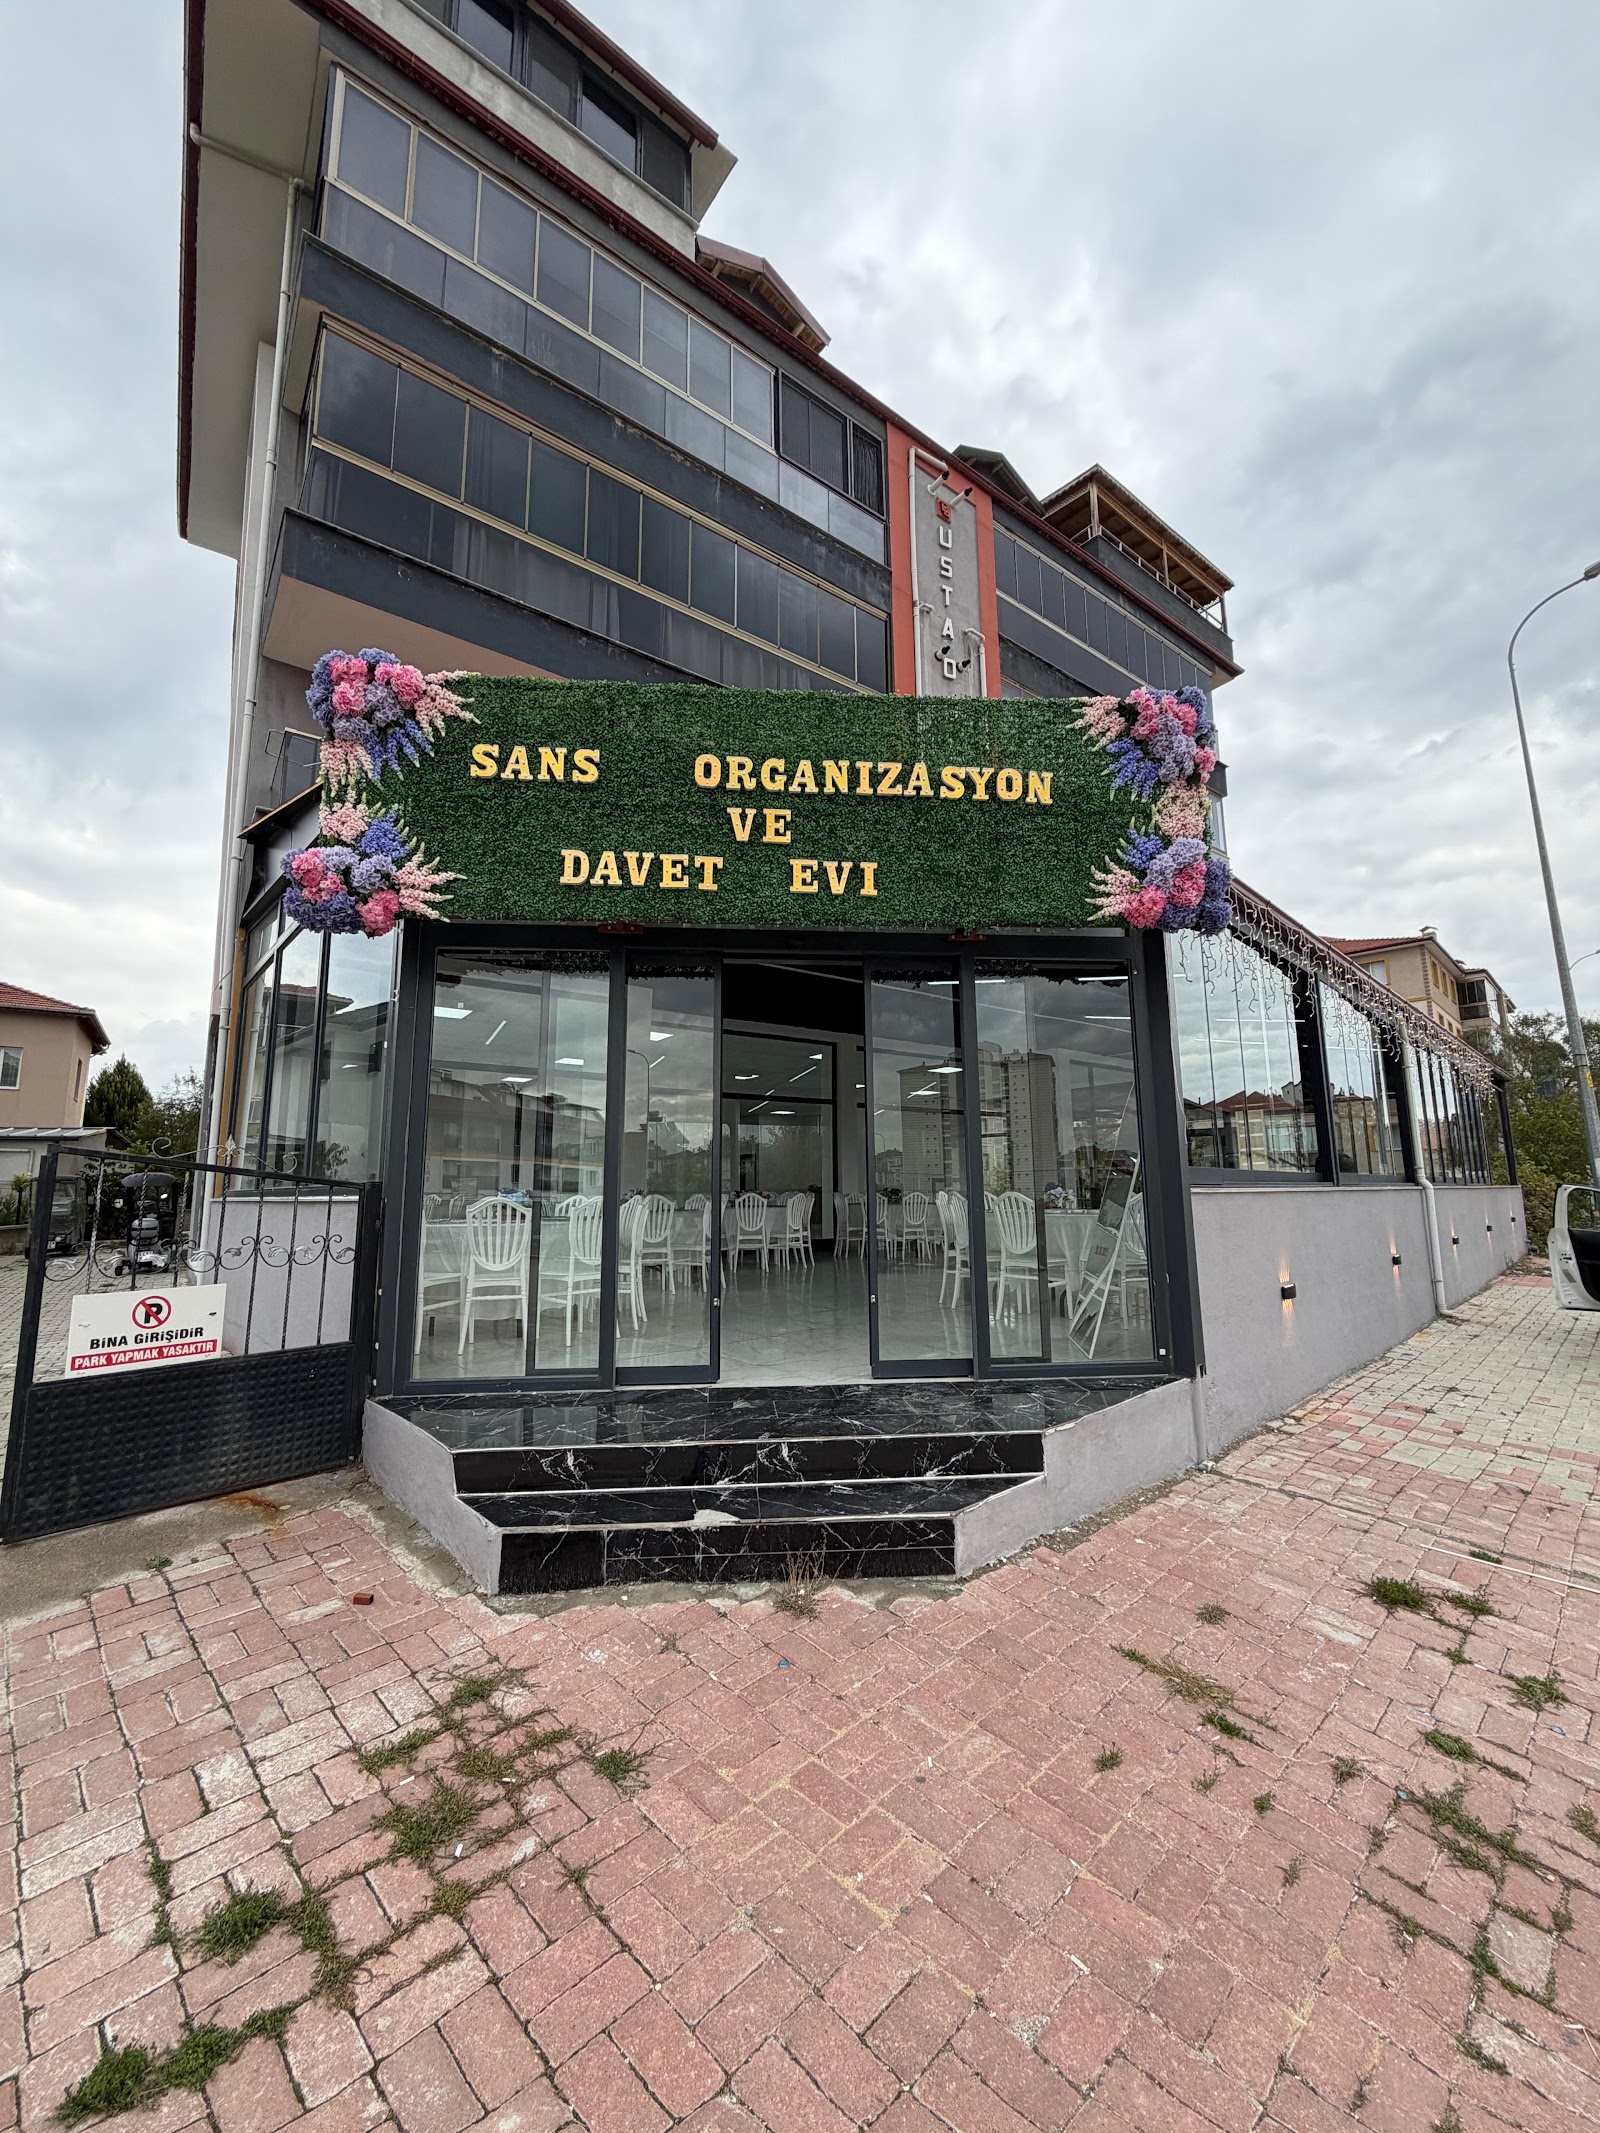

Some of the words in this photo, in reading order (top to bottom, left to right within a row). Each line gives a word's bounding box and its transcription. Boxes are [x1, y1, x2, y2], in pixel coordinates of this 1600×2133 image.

[470, 744, 600, 783] SANS
[694, 754, 1053, 804] ORGANIZASYON
[726, 807, 792, 844] VE
[560, 849, 723, 891] DAVET
[789, 859, 878, 896] EVI
[74, 1354, 107, 1369] PARK
[110, 1348, 159, 1364] YAPMAK
[162, 1341, 214, 1357] YASAKTIR
